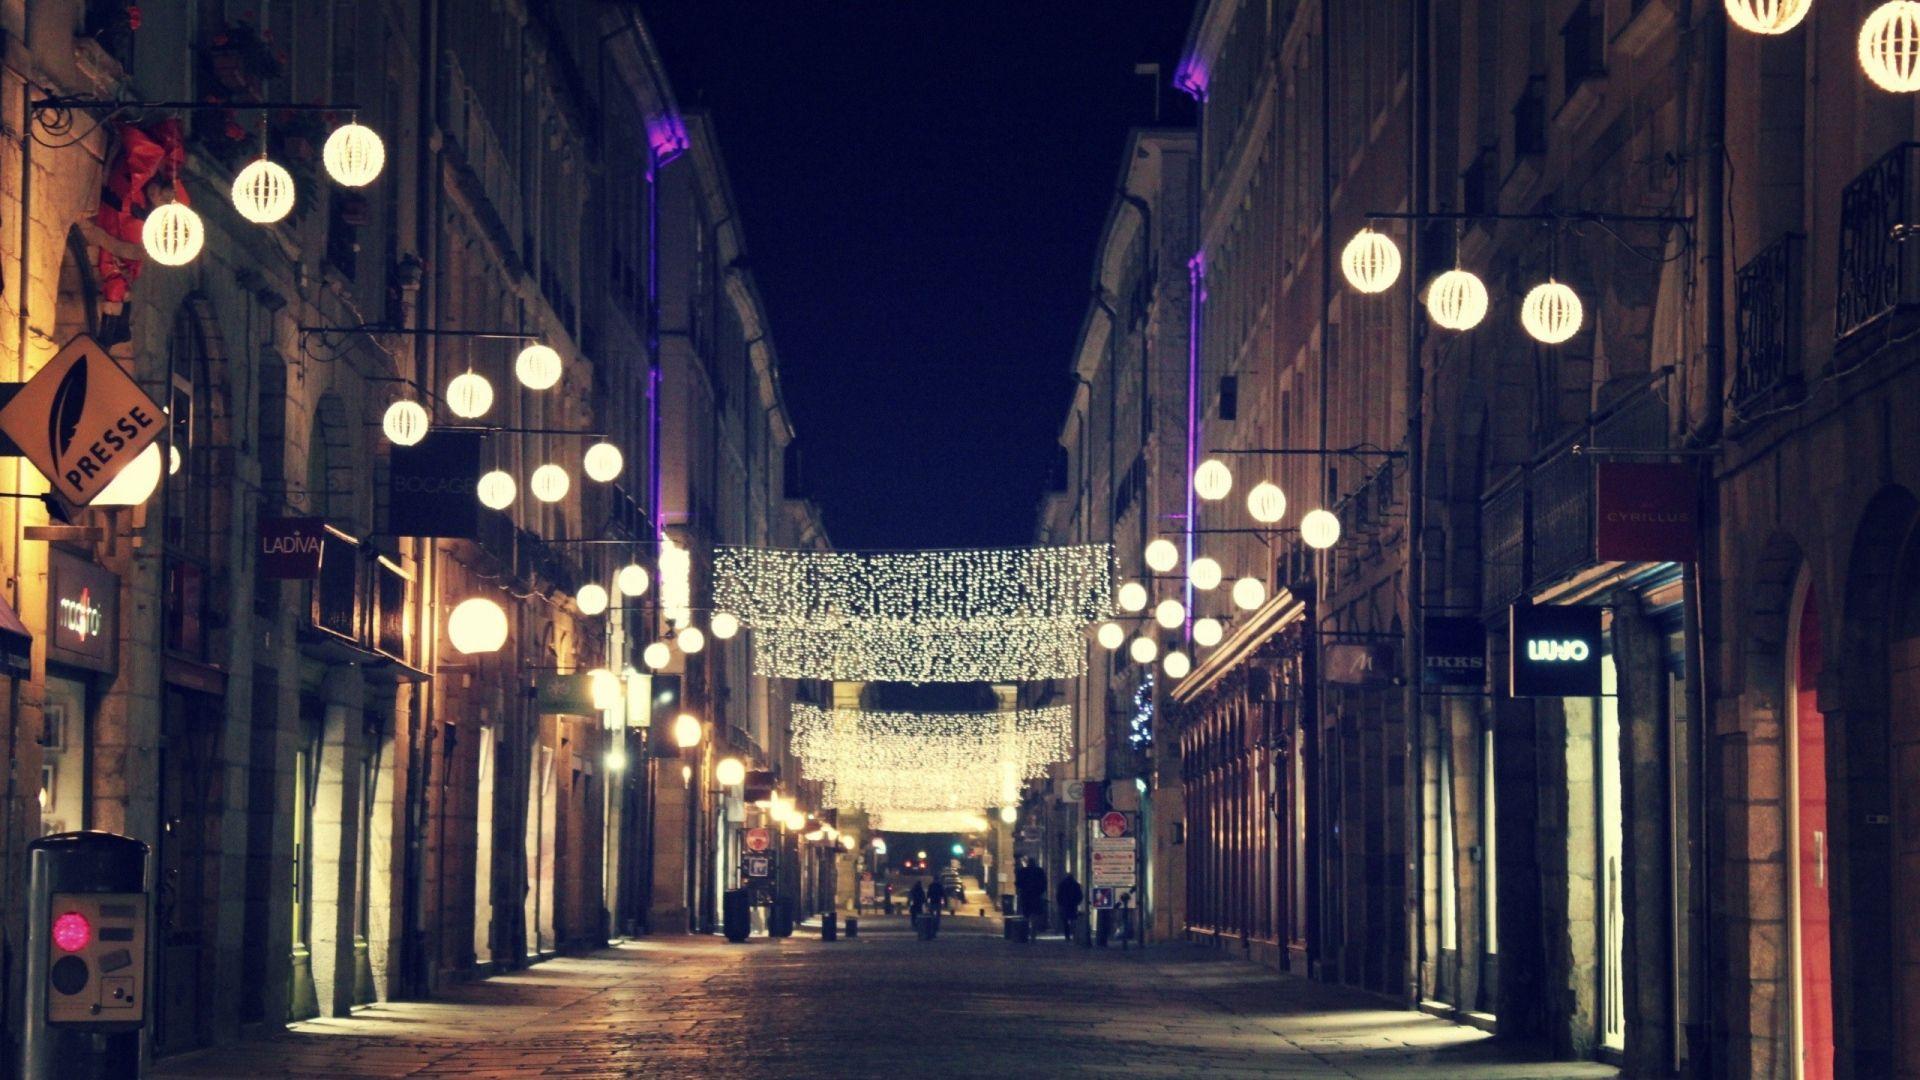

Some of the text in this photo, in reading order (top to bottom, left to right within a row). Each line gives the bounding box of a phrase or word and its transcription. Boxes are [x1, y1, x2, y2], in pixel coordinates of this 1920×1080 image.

[65, 406, 153, 492] PRESSE
[1607, 511, 1689, 523] CYRILLUS
[1424, 656, 1483, 669] IKKS
